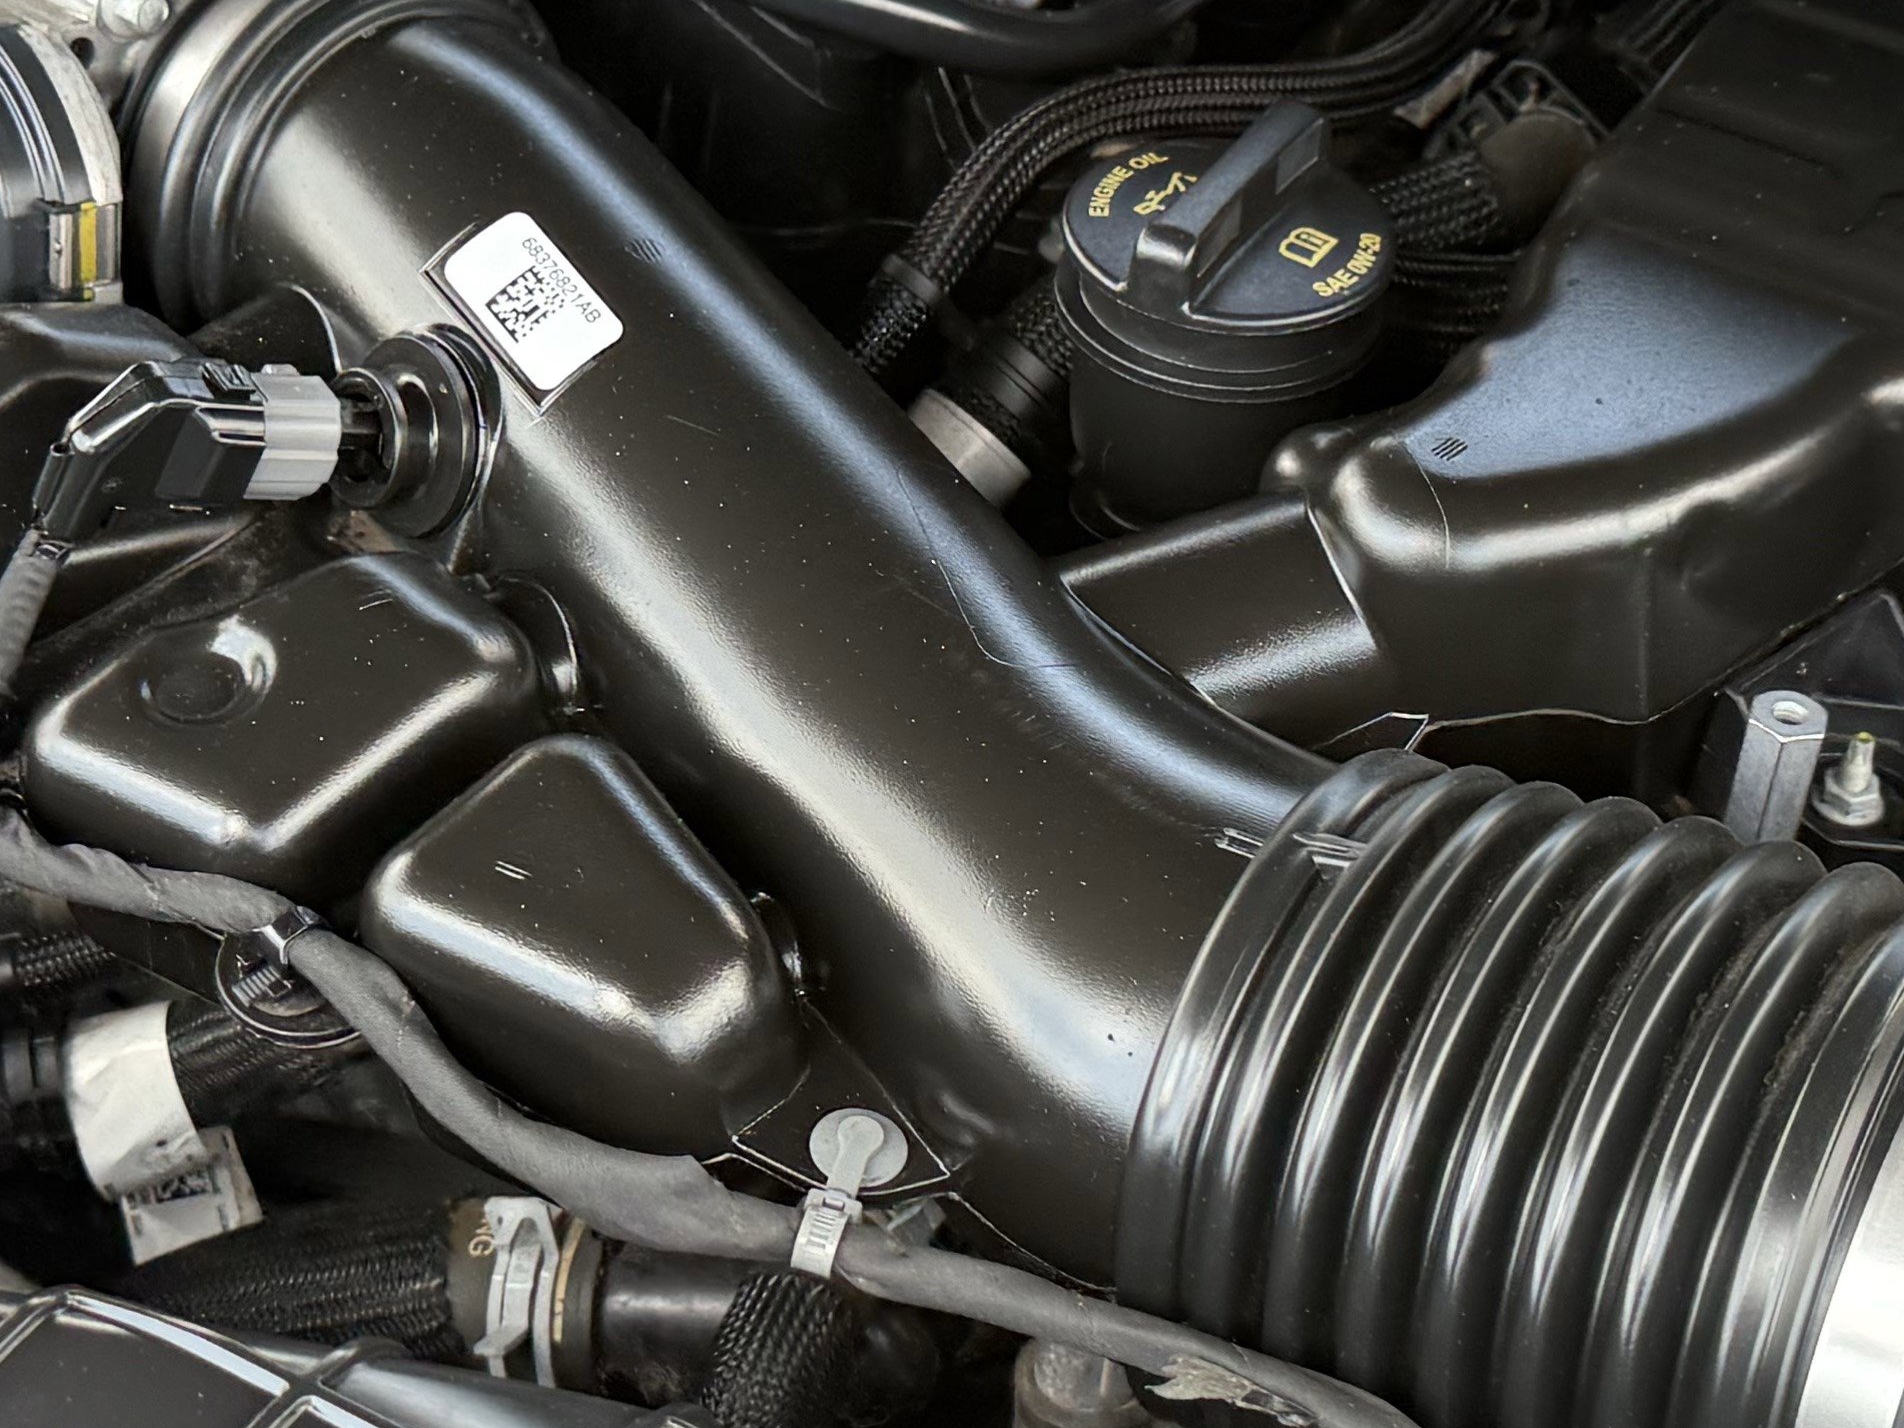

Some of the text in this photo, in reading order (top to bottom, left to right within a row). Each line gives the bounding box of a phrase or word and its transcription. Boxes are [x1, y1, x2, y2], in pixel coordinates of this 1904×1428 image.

[1088, 152, 1169, 217] ENGINE OIL
[521, 236, 602, 324] 68376821AB
[1312, 268, 1359, 297] SAE
